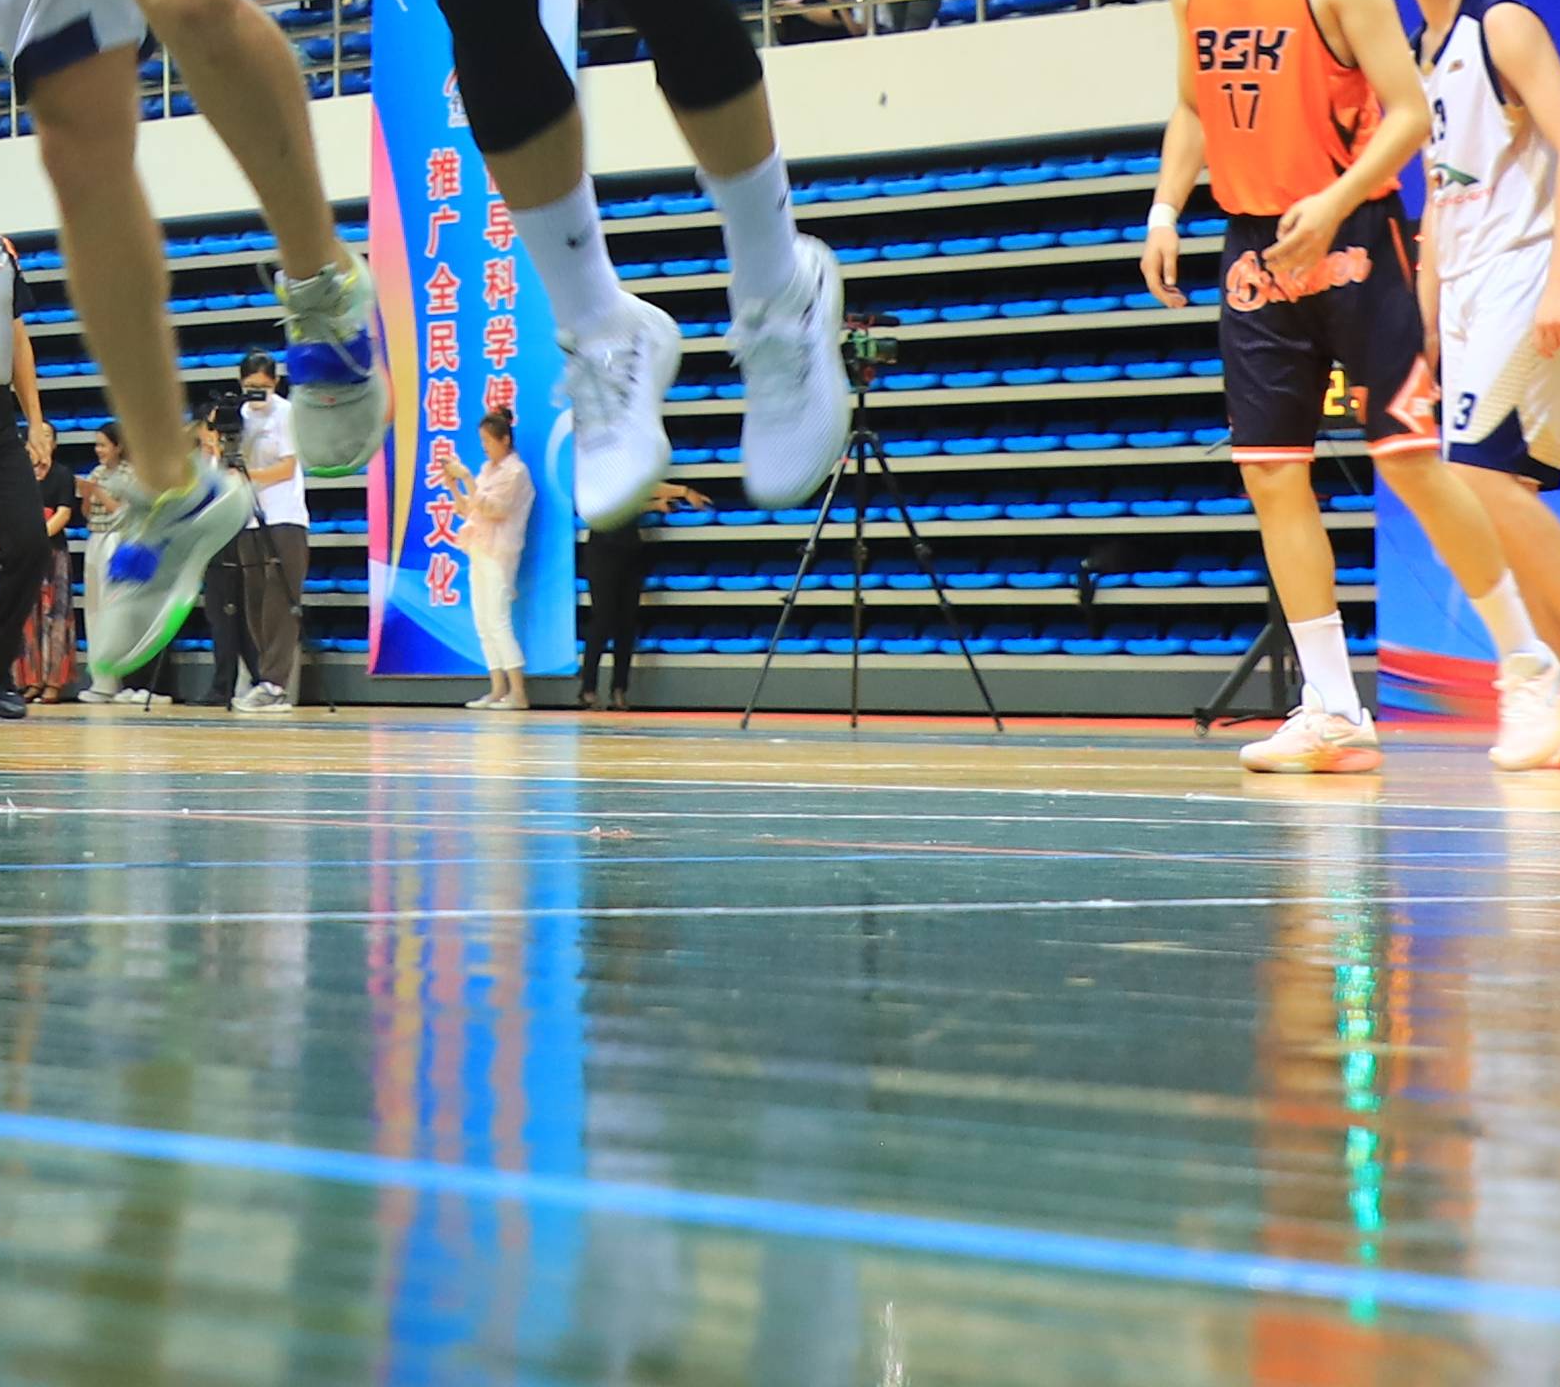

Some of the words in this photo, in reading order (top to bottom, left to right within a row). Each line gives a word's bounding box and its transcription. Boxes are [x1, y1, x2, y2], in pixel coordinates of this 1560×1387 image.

[1194, 27, 1297, 74] BSK
[1220, 82, 1261, 131] 17
[483, 167, 519, 426] 导科学健
[424, 146, 463, 607] 推广全民健身文化
[1454, 391, 1477, 431] 3
